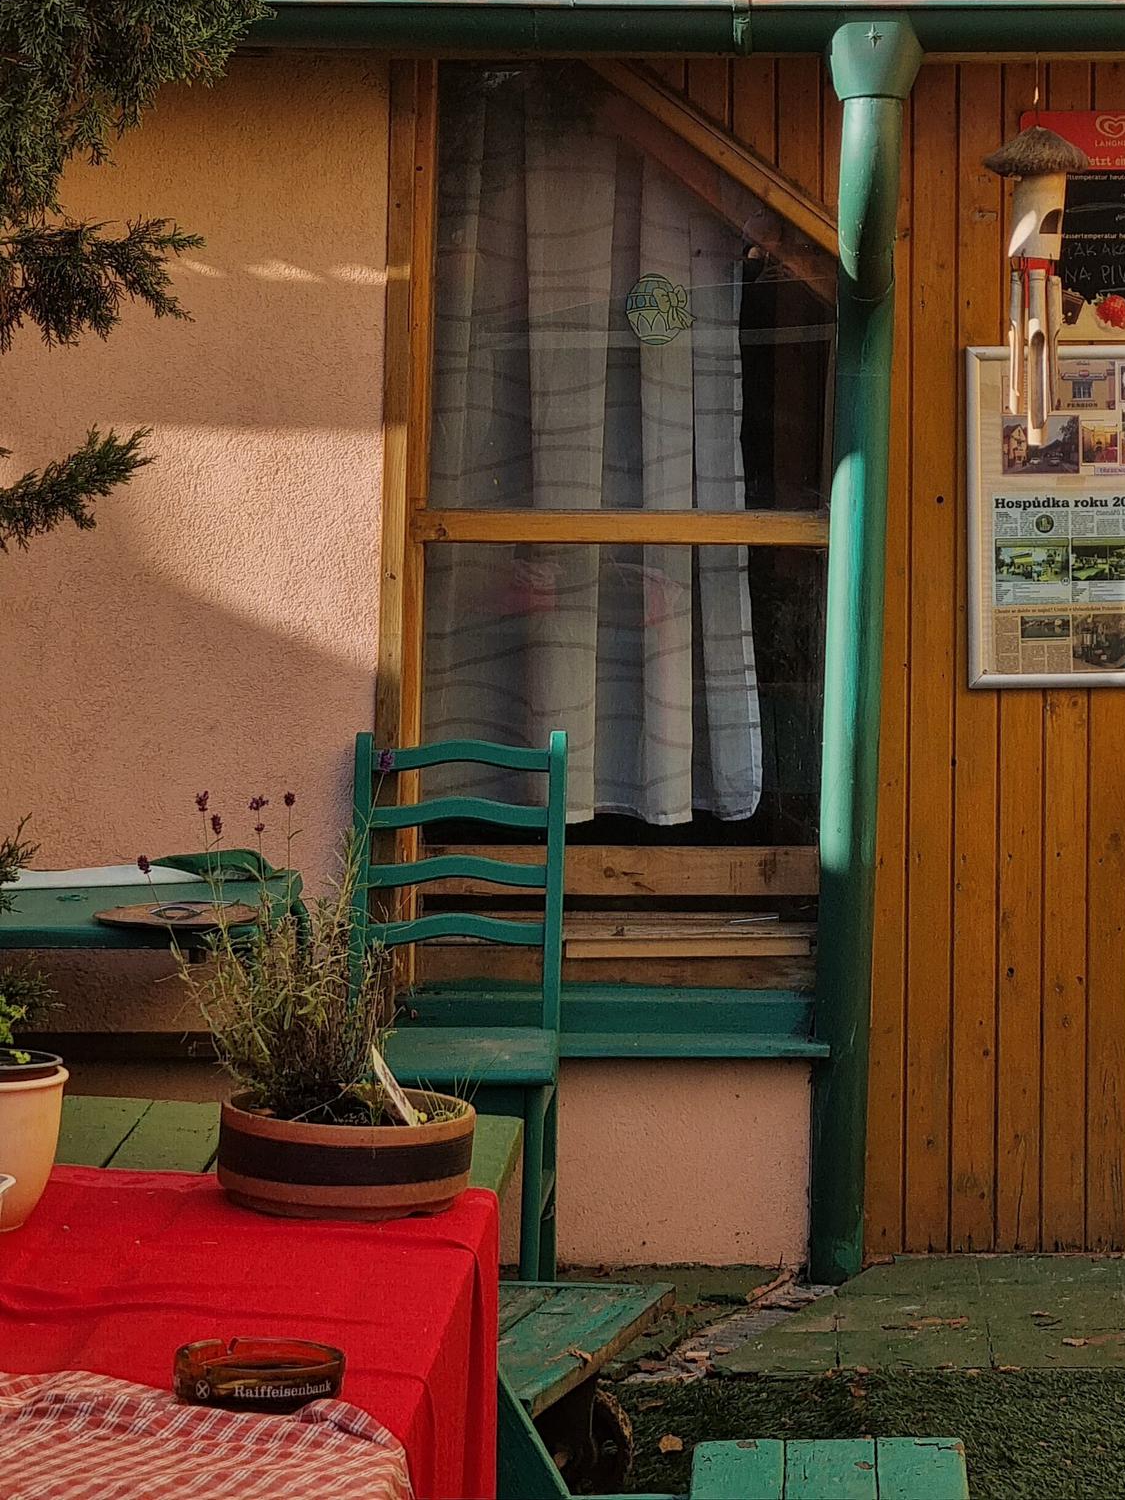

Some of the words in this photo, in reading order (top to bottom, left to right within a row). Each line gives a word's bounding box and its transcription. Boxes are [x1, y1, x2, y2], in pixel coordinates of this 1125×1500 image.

[1065, 266, 1092, 283] NA
[994, 497, 1070, 511] Hospůdka
[1074, 497, 1109, 508] roku
[233, 1380, 332, 1399] Raiffeisenbank
